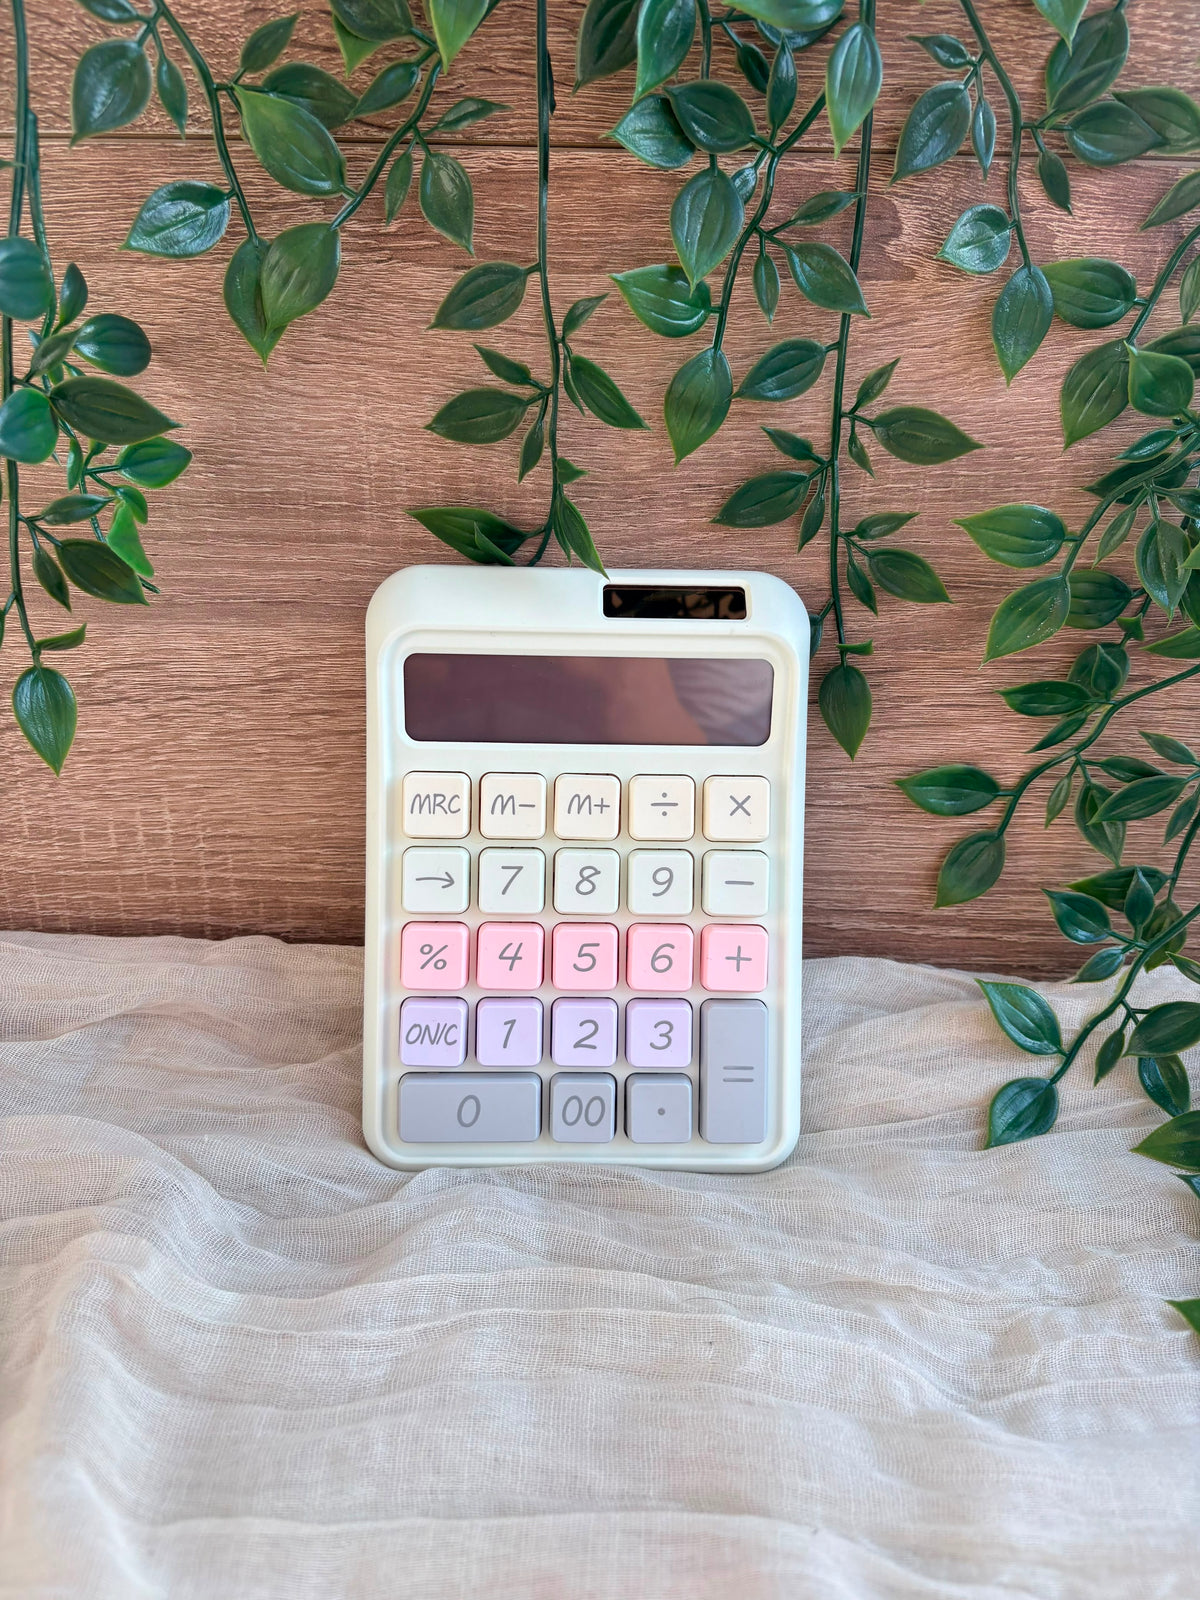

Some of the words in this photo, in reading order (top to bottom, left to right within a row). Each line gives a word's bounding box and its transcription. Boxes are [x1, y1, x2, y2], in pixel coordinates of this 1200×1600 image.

[410, 793, 461, 815] MRC
[567, 793, 611, 816] M+
[501, 865, 524, 896] 7
[575, 865, 602, 896] 8
[652, 866, 674, 897] 9
[419, 943, 449, 970] %
[498, 942, 524, 972] 4
[572, 942, 601, 973] 5
[650, 942, 676, 974] 6
[405, 1022, 458, 1046] ON/C
[502, 1018, 517, 1049] 1
[573, 1019, 599, 1050] 2
[649, 1020, 674, 1051] 3
[456, 1094, 481, 1128] 0
[561, 1095, 606, 1127] 00
